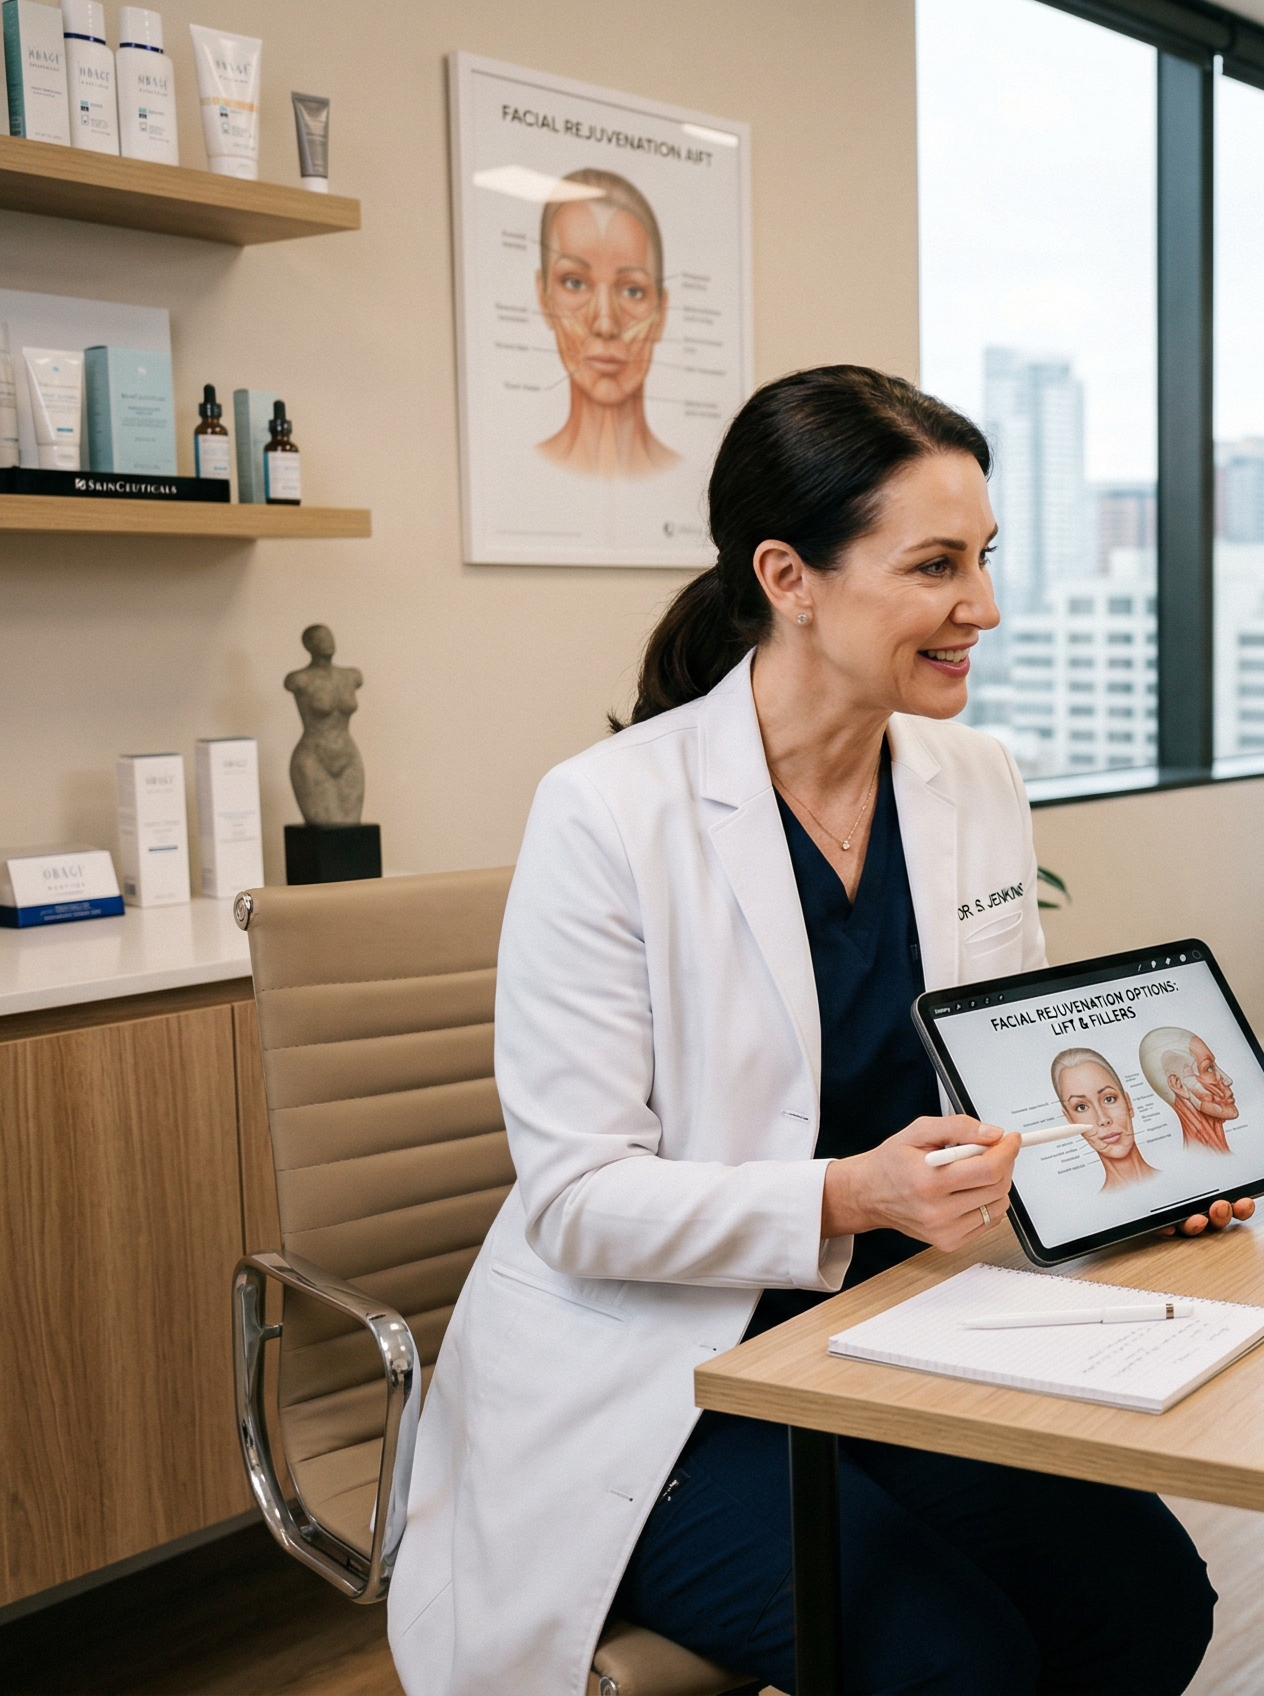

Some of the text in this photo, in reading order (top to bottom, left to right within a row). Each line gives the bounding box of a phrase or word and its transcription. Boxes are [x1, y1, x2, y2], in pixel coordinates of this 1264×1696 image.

[502, 105, 559, 133] FACIAL
[564, 114, 681, 160] REJUVENATION
[990, 980, 1179, 1032] FACIAL REJUVENATION OPTIONS:
[1051, 1018, 1077, 1036] LIFT
[1089, 1006, 1137, 1027] FILLERS
